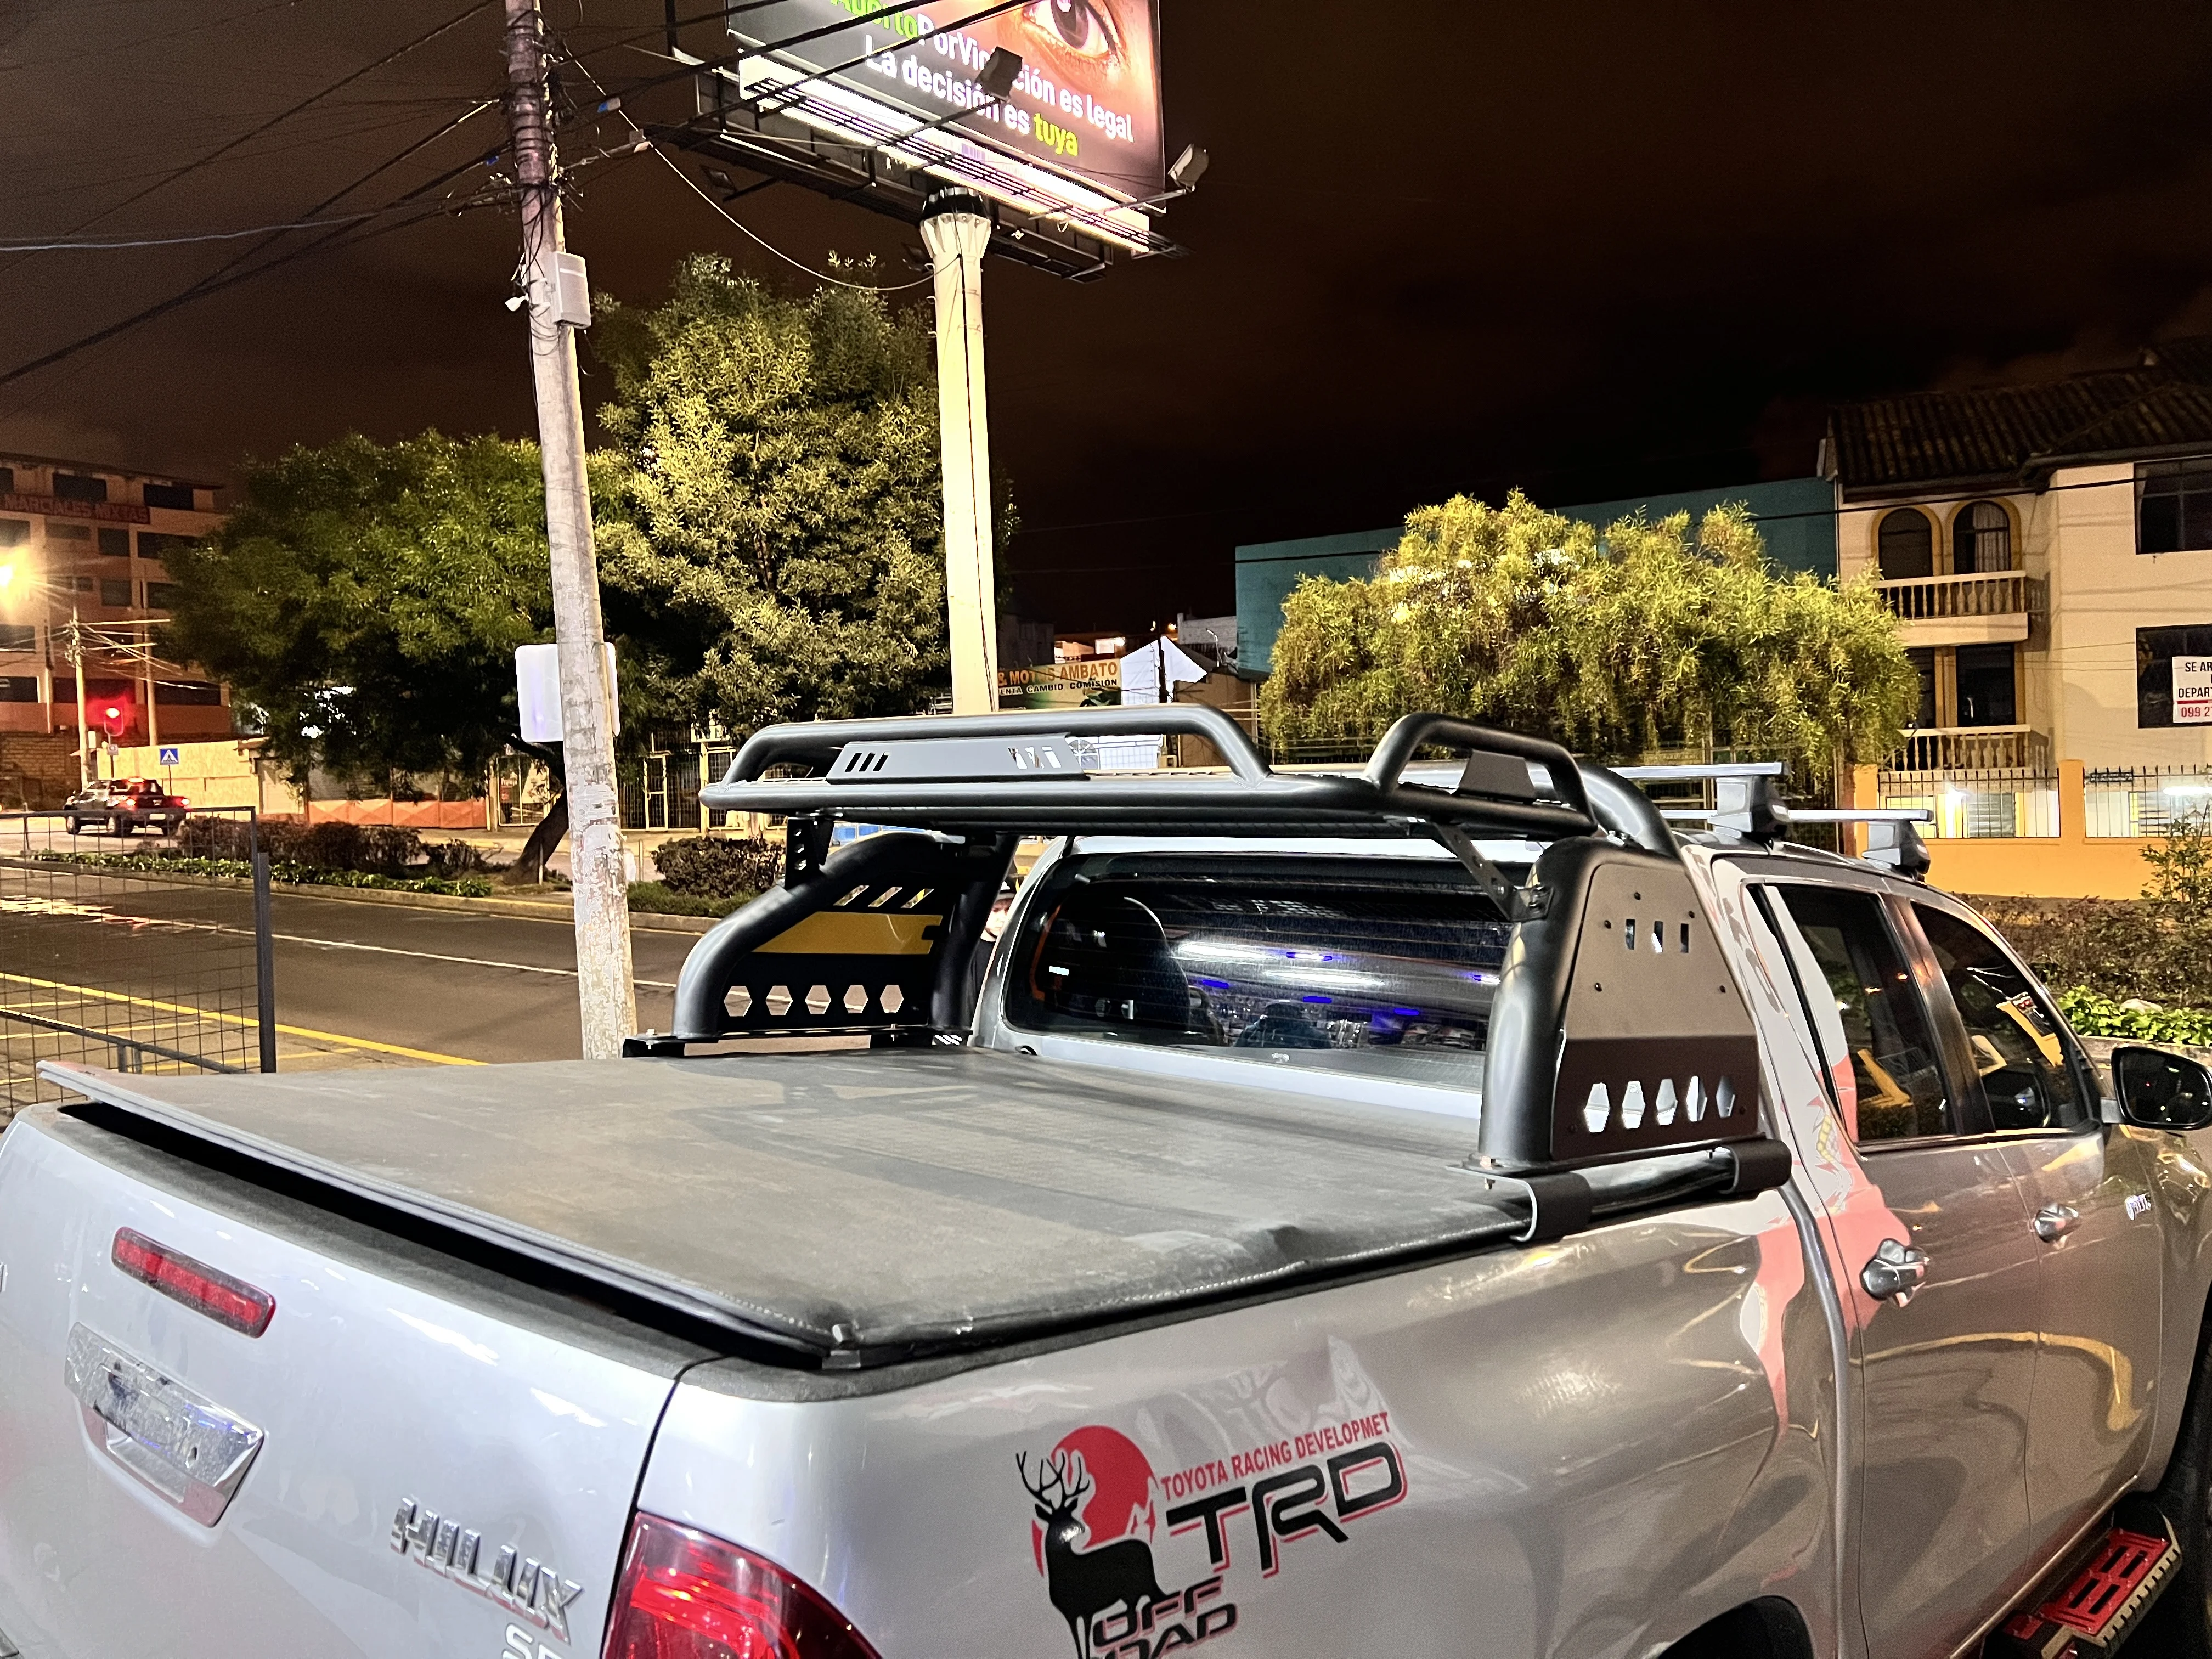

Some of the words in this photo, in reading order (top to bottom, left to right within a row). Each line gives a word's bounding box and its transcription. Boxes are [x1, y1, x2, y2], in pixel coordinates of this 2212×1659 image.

[865, 34, 897, 78] La
[902, 55, 1000, 122] decisión
[1003, 104, 1030, 135] es
[1034, 112, 1078, 156] tuya
[1059, 88, 1084, 118] es
[1086, 94, 1134, 143] legal
[1026, 684, 1064, 693] CAMBIO
[1069, 679, 1118, 690] COMISIÓN
[1060, 662, 1118, 680] AMBATO
[2178, 687, 2212, 698] DEPAR
[2185, 662, 2197, 673] SE
[2181, 707, 2200, 718] 099
[1161, 1460, 1229, 1501] TOYOTA
[1231, 1440, 1292, 1479] RACING
[1294, 1411, 1391, 1460] DEVELOPMET
[1166, 1441, 1408, 1578] TRD
[390, 1497, 584, 1646] HILUX
[1092, 1575, 1223, 1652] OFF
